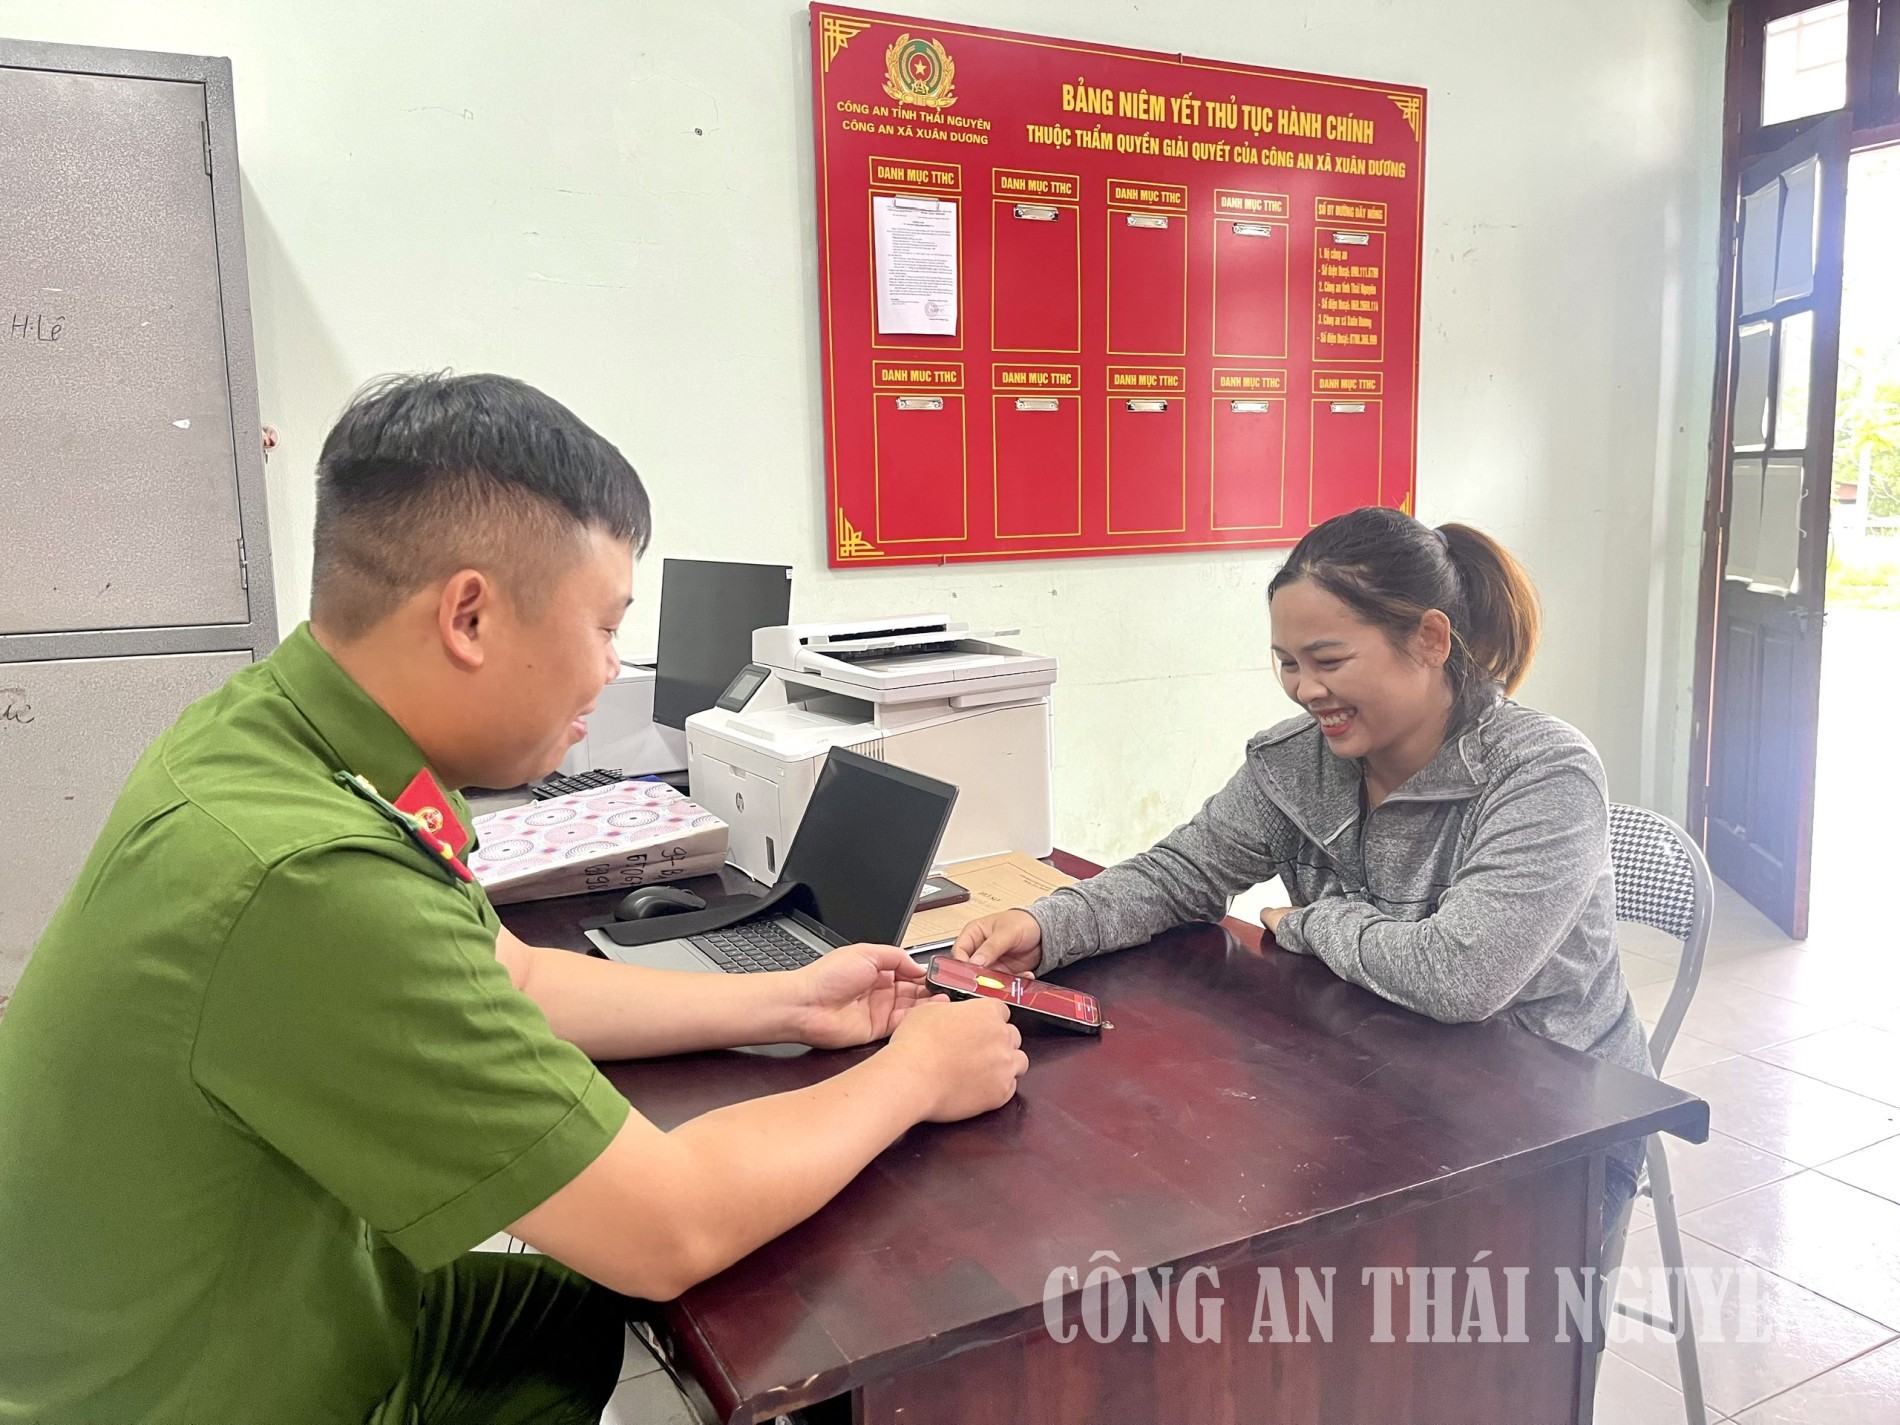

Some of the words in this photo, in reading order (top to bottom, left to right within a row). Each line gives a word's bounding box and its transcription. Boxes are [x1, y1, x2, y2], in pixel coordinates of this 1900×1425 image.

[836, 101, 870, 115] CÔNG
[872, 106, 889, 117] AN
[891, 104, 917, 121] TỈNH
[919, 110, 945, 124] THÁI
[947, 115, 991, 131] NGUYÊN
[1062, 76, 1114, 116] BẢNG
[1119, 88, 1166, 122] NIÊM
[1170, 91, 1202, 126] YẾT
[1205, 95, 1238, 130] THỦ
[1241, 104, 1273, 137] TỤC
[1277, 105, 1322, 139] HÀNH
[1326, 112, 1375, 144] CHÍNH
[842, 119, 875, 133] CÔNG
[878, 124, 894, 135] AN
[897, 125, 913, 137] XÃ
[916, 128, 948, 141] XUÂN
[950, 132, 989, 145] DƯƠNG
[1027, 123, 1071, 149] THUỘC
[1075, 123, 1113, 150] THẨM
[1117, 131, 1160, 155] QUYỀN
[1163, 135, 1189, 158] GIẢI
[1192, 139, 1231, 162] QUYẾT
[1233, 141, 1259, 165] CỦA
[1261, 146, 1294, 168] CÔNG
[1297, 152, 1314, 170] AN
[1316, 152, 1332, 172] XÃ
[1335, 155, 1366, 176] XUÂN
[1368, 159, 1406, 179] DƯƠNG
[877, 165, 905, 181] DANH
[907, 168, 930, 185] MỤC
[931, 170, 955, 185] TTHC
[1001, 176, 1026, 191] DANH
[1028, 179, 1049, 195] MỤC
[1051, 181, 1072, 195] TTHC
[1115, 187, 1138, 201] DANH
[1140, 190, 1159, 204] MỤC
[1161, 191, 1181, 204] TTHC
[1221, 196, 1243, 210] DANH
[1244, 198, 1263, 213] MỤC
[1264, 200, 1282, 213] TTHC
[881, 369, 908, 382] DANH
[934, 371, 957, 383] TTHC
[1002, 372, 1027, 384] DANH
[1028, 373, 1049, 386] MỤC
[1051, 373, 1072, 385] TTHC
[1114, 374, 1137, 386] DANH
[1139, 375, 1158, 389] MỤC
[1159, 375, 1179, 387] TTHC
[1220, 376, 1242, 388] DANH
[1262, 378, 1280, 389] TTHC
[1319, 378, 1339, 390] DANH
[1359, 379, 1377, 390] TTHC
